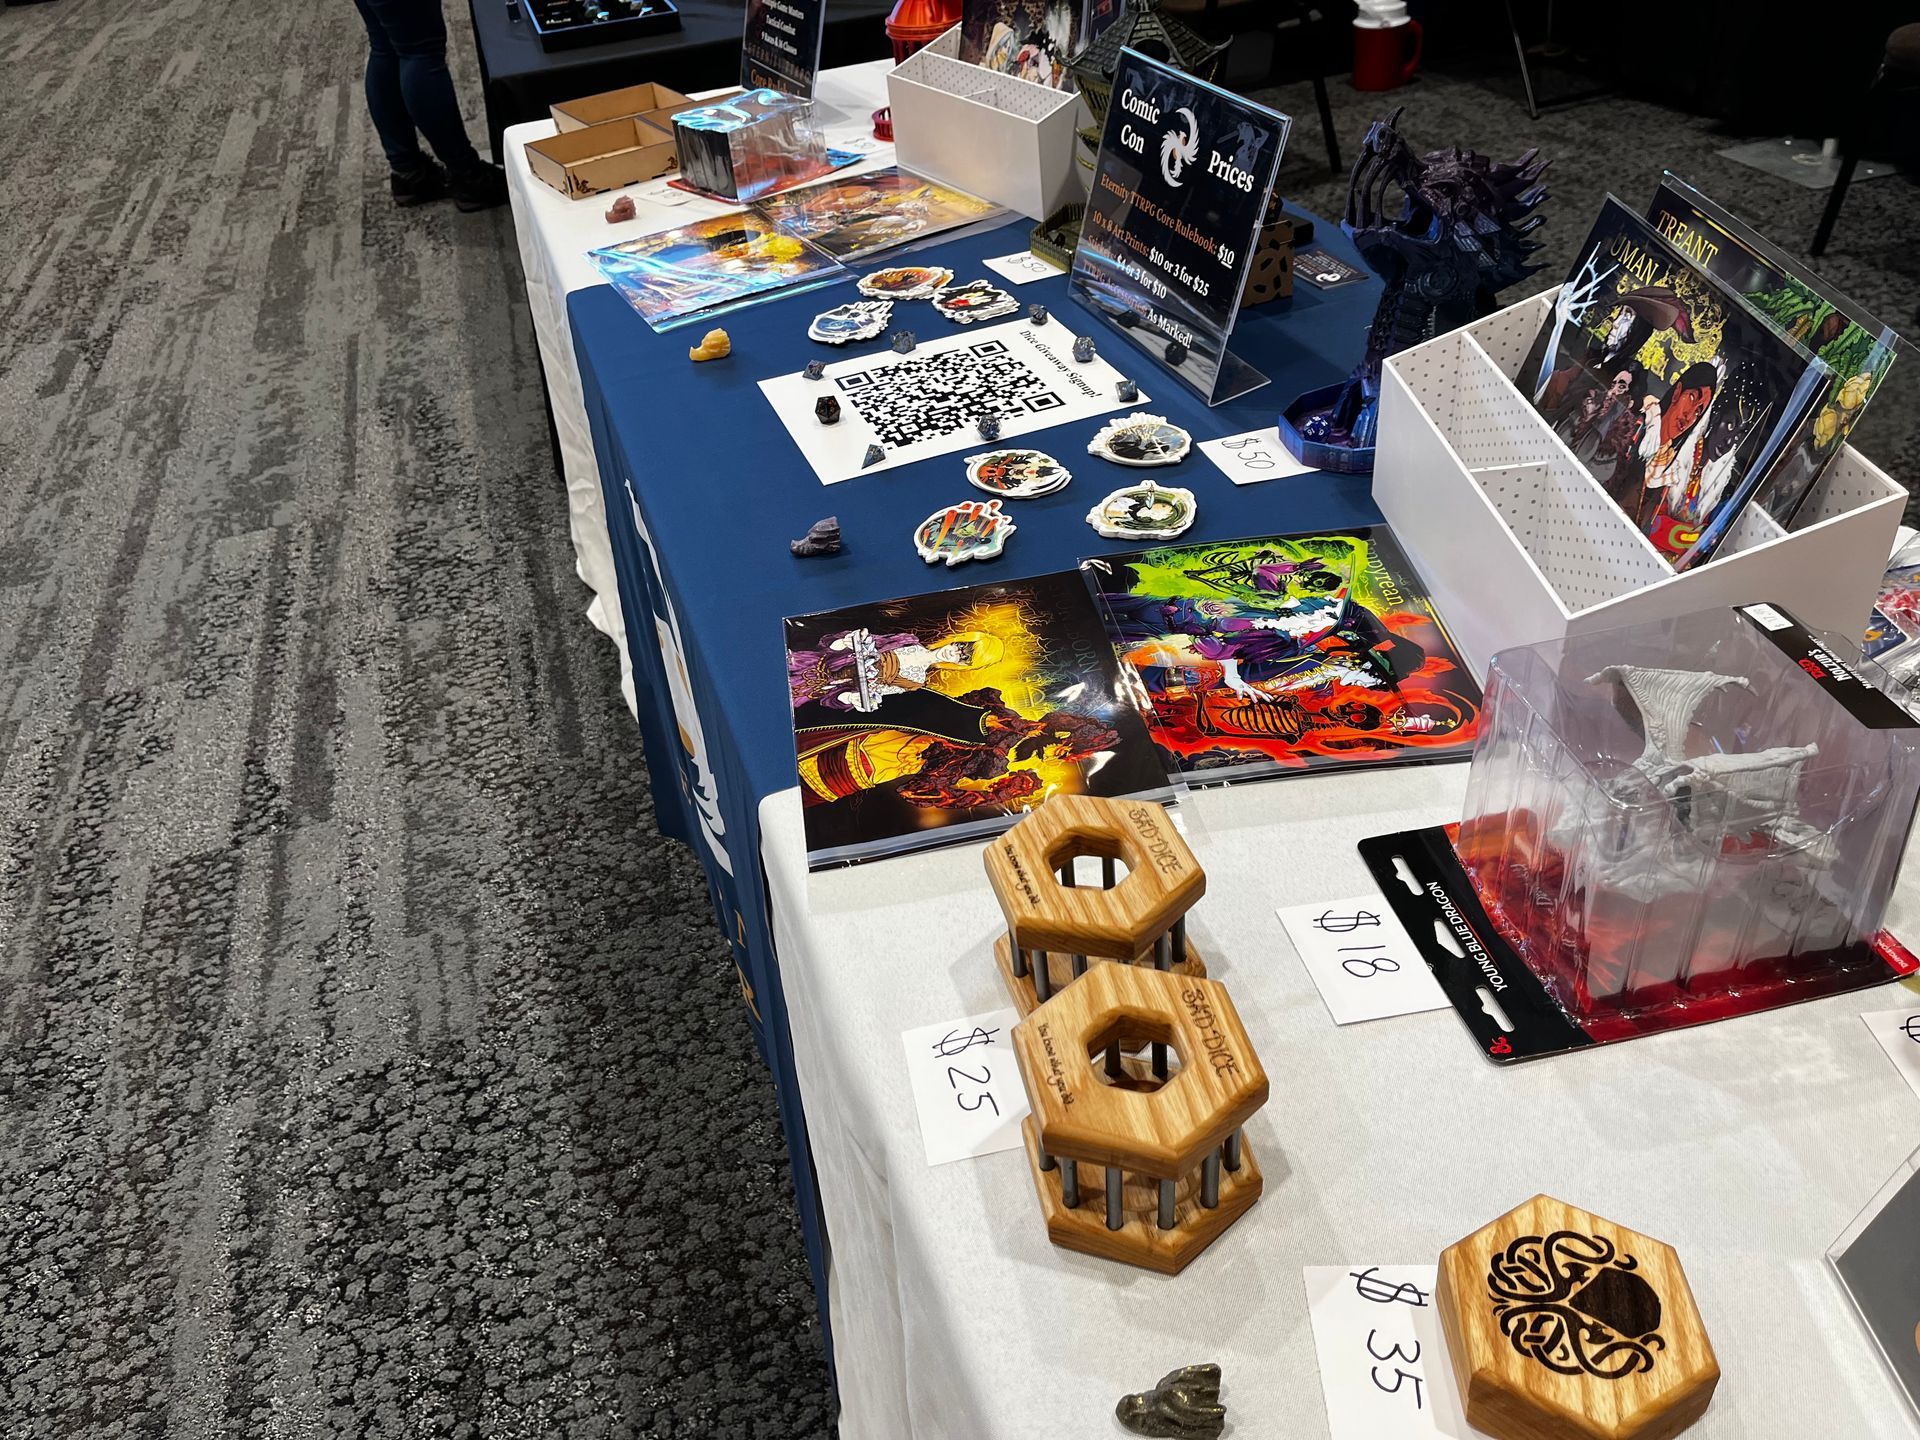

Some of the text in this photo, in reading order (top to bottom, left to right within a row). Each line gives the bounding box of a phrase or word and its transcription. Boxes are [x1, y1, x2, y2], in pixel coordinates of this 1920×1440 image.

[1121, 88, 1160, 124] Comic
[1121, 124, 1144, 154] Con
[1207, 150, 1254, 192] Prices
[1100, 173, 1235, 267] Eternity TTRPG Core Rulebook: $10
[1656, 210, 1718, 269] TREANT
[1092, 210, 1210, 297] 10 x 8 Art Prints: $10 or 3 for $25
[1116, 253, 1126, 271] $4
[1126, 264, 1134, 276] or
[1134, 268, 1140, 281] 3
[1140, 270, 1153, 290] for
[1152, 279, 1167, 299] $10
[1147, 308, 1158, 324] As
[1157, 314, 1193, 349] Marked!
[1020, 330, 1103, 398] Dice Giveaway Signup!
[1222, 438, 1276, 470] $50
[1313, 910, 1400, 978] $18
[1426, 881, 1508, 992] YOUNG BLUE DRAGON
[1038, 1022, 1049, 1037] You
[1202, 1029, 1240, 1078] DICE
[932, 1027, 1000, 1116] $25
